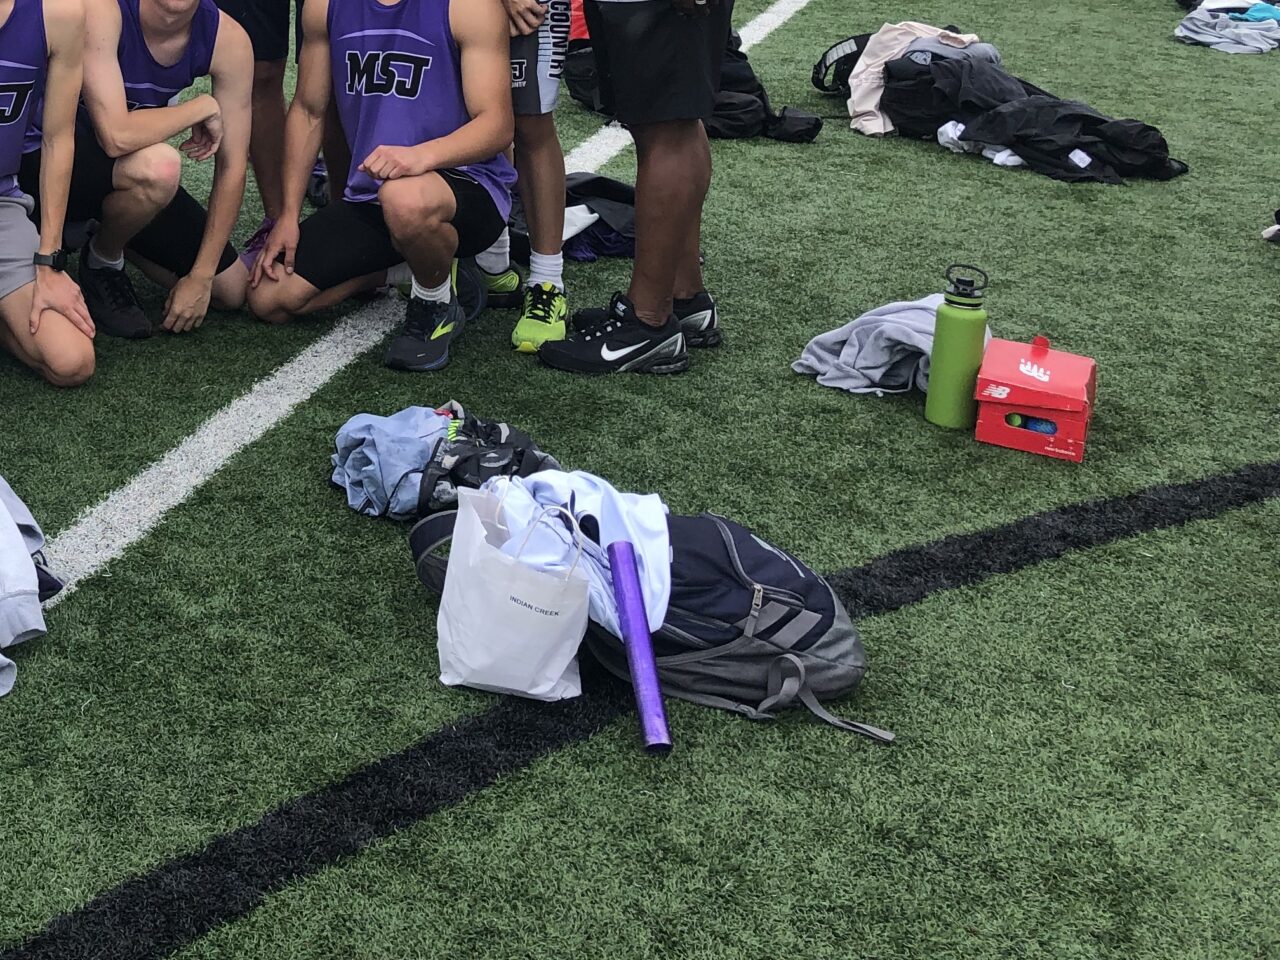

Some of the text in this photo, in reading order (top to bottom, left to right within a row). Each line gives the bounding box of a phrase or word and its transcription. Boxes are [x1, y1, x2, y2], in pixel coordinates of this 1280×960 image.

[346, 50, 432, 100] MSJ
[510, 595, 560, 616] INDIAN CREEK
